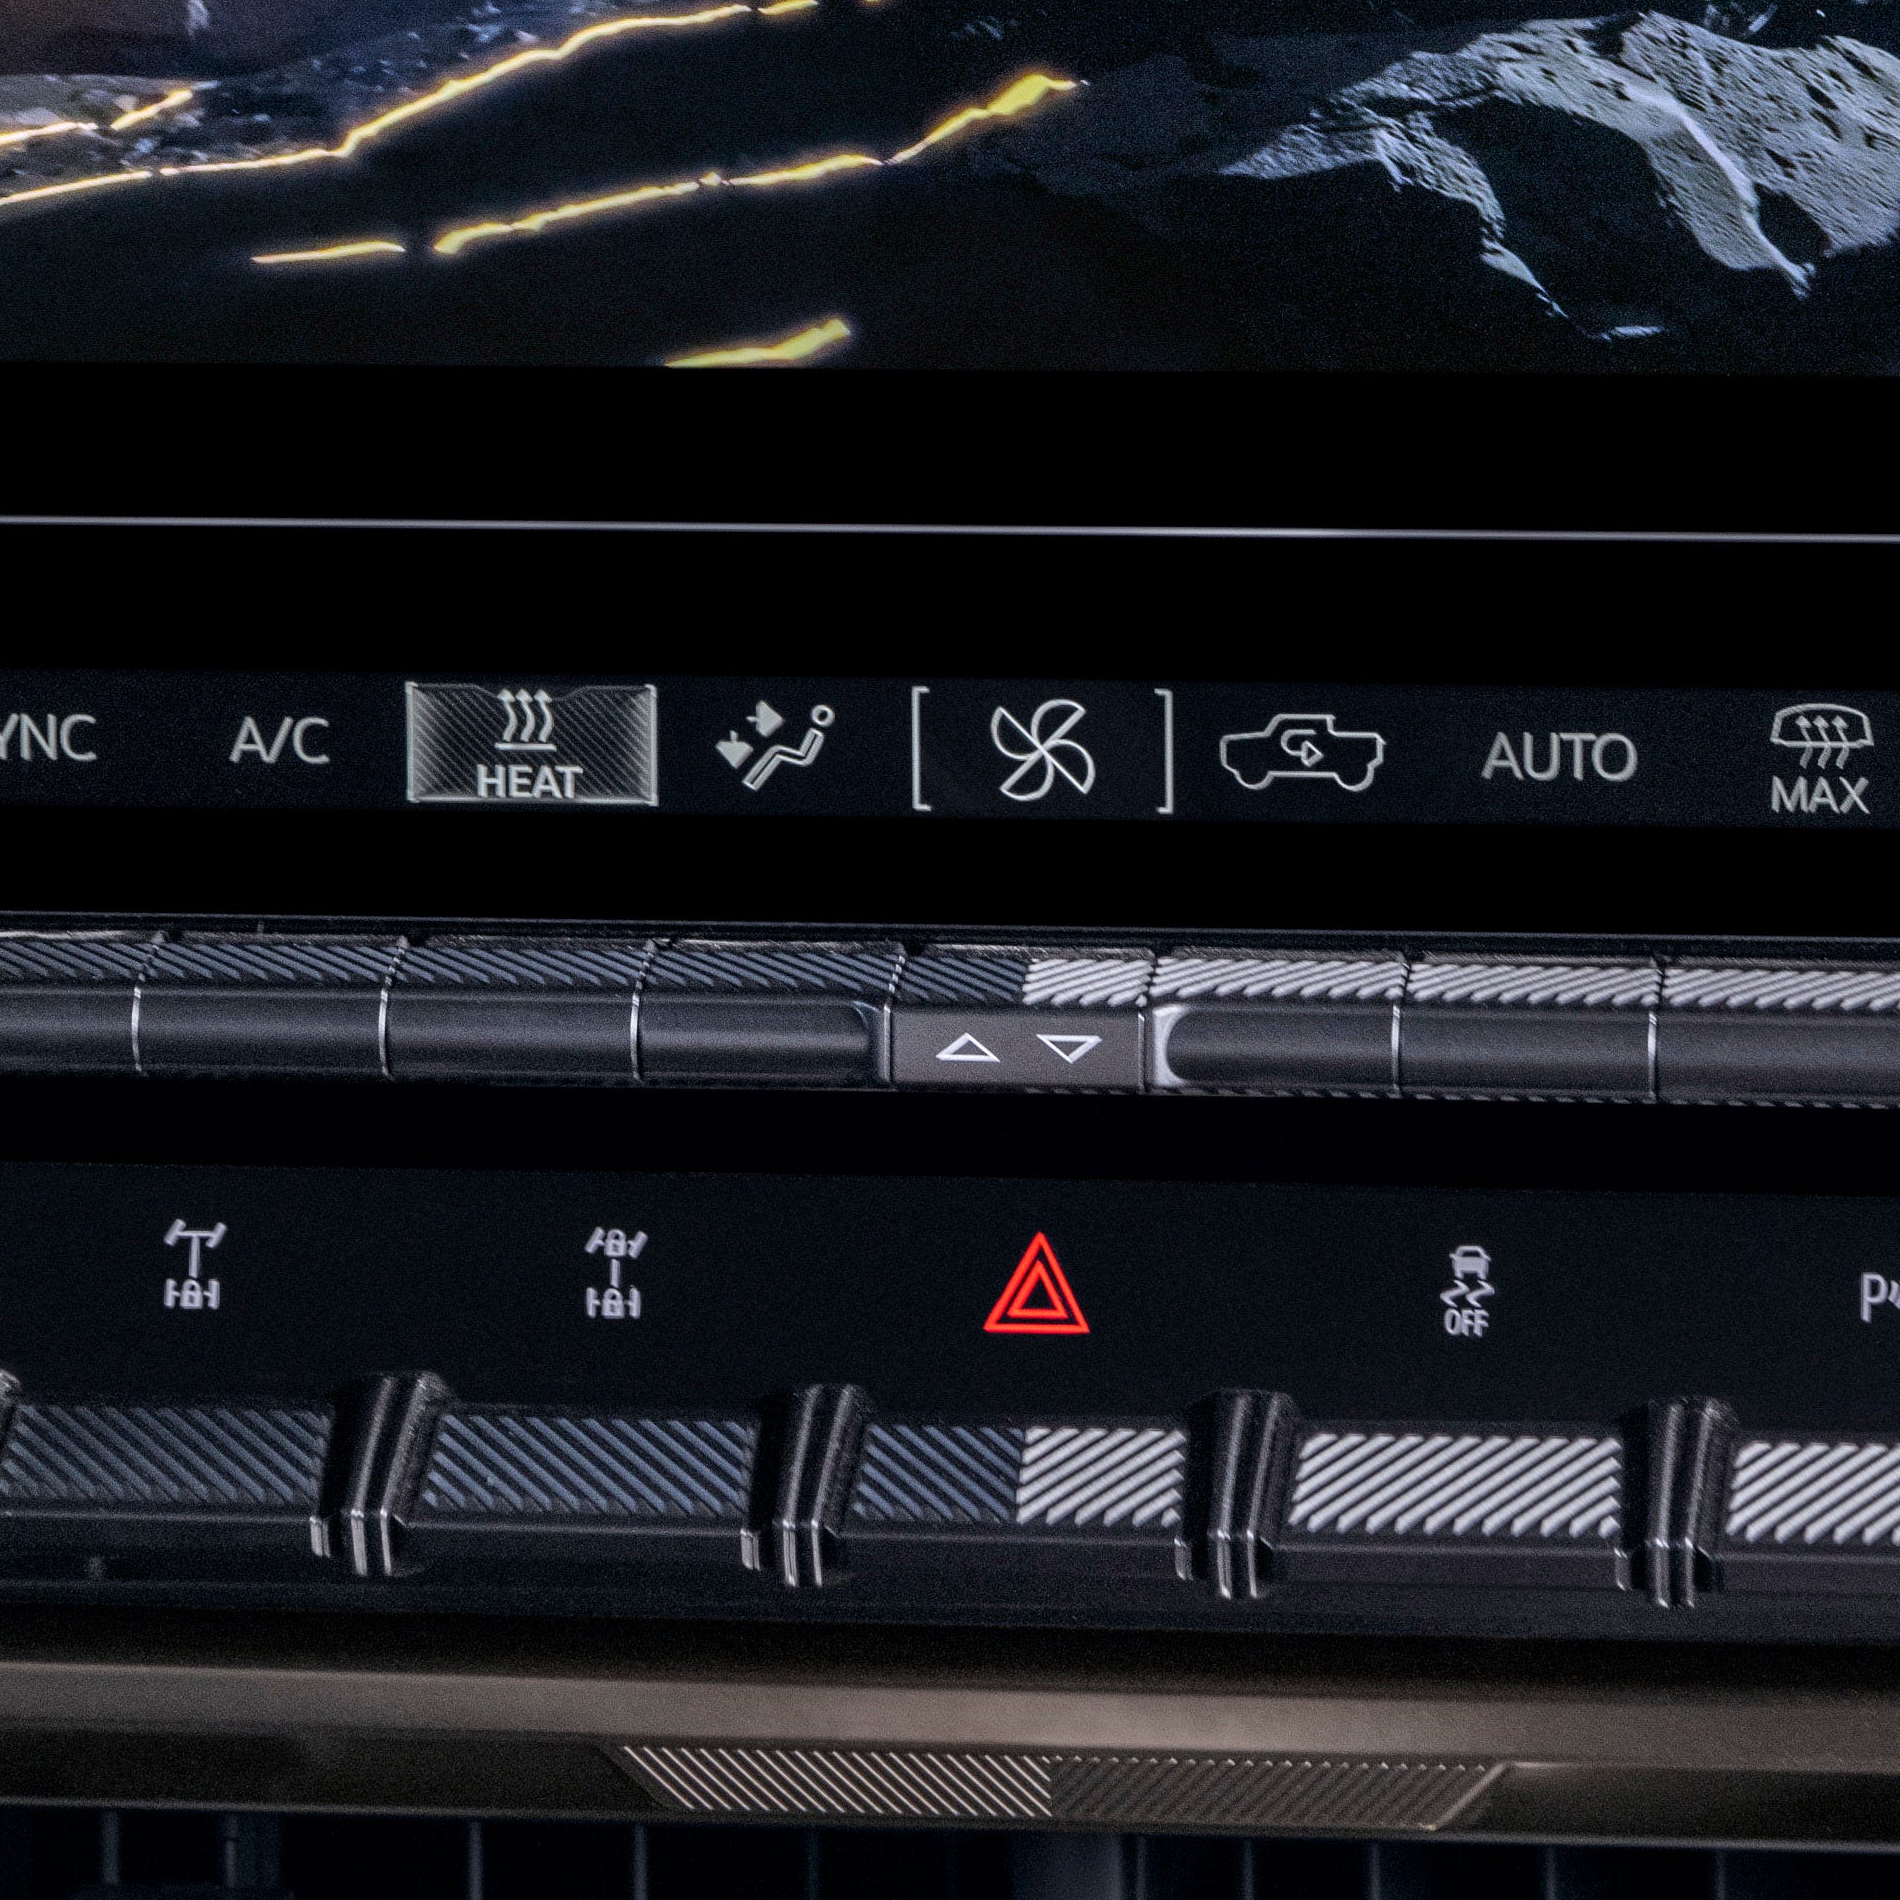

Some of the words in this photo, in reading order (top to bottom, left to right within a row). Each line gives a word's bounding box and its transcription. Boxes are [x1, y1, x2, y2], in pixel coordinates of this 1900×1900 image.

[229, 714, 330, 765] A/C
[1480, 731, 1638, 782] AUTO
[476, 762, 582, 800] HEAT
[1771, 775, 1870, 815] MAX
[1444, 1307, 1490, 1338] OFF
